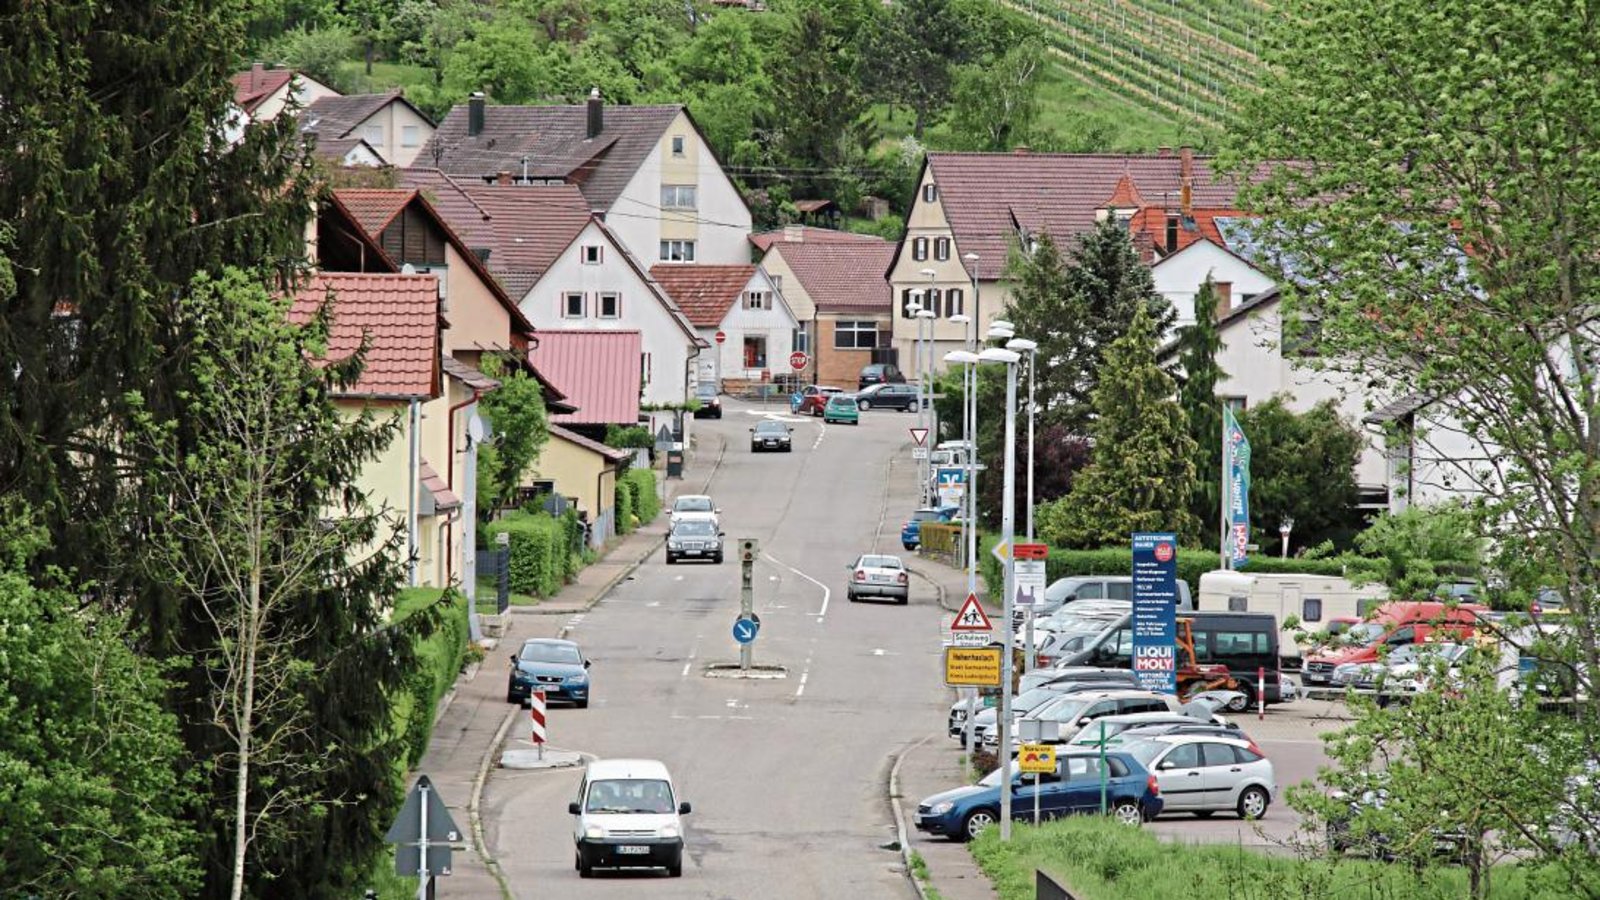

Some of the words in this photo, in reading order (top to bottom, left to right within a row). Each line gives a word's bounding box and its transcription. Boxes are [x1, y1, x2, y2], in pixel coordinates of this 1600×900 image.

[791, 356, 806, 365] STOP
[956, 633, 988, 642] Schulweg
[1137, 646, 1172, 658] LIQUI
[1137, 658, 1172, 670] MOLY
